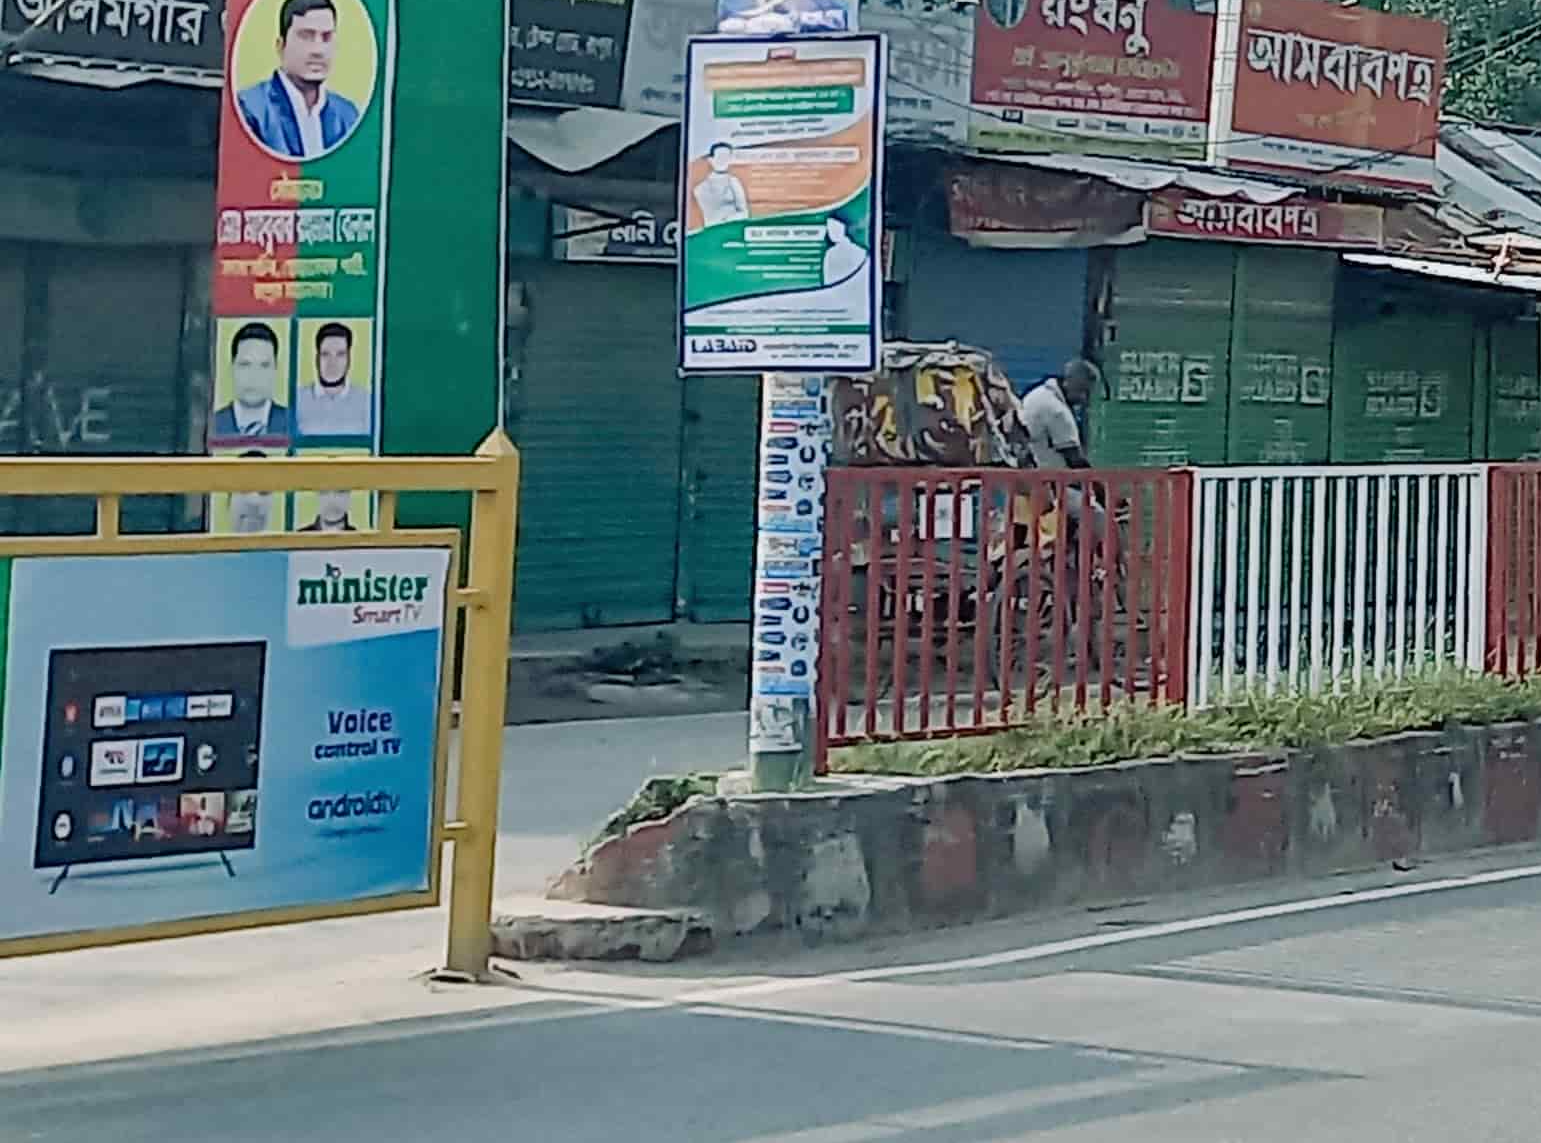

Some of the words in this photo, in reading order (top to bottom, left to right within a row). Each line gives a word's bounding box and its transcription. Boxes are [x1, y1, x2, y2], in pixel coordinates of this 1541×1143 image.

[1247, 28, 1436, 108] আসবাবপত্র
[1176, 197, 1322, 238] আসবাবপত্র
[297, 566, 429, 605] minister
[327, 708, 393, 735] Voice
[314, 738, 377, 761] control
[382, 737, 402, 756] TV
